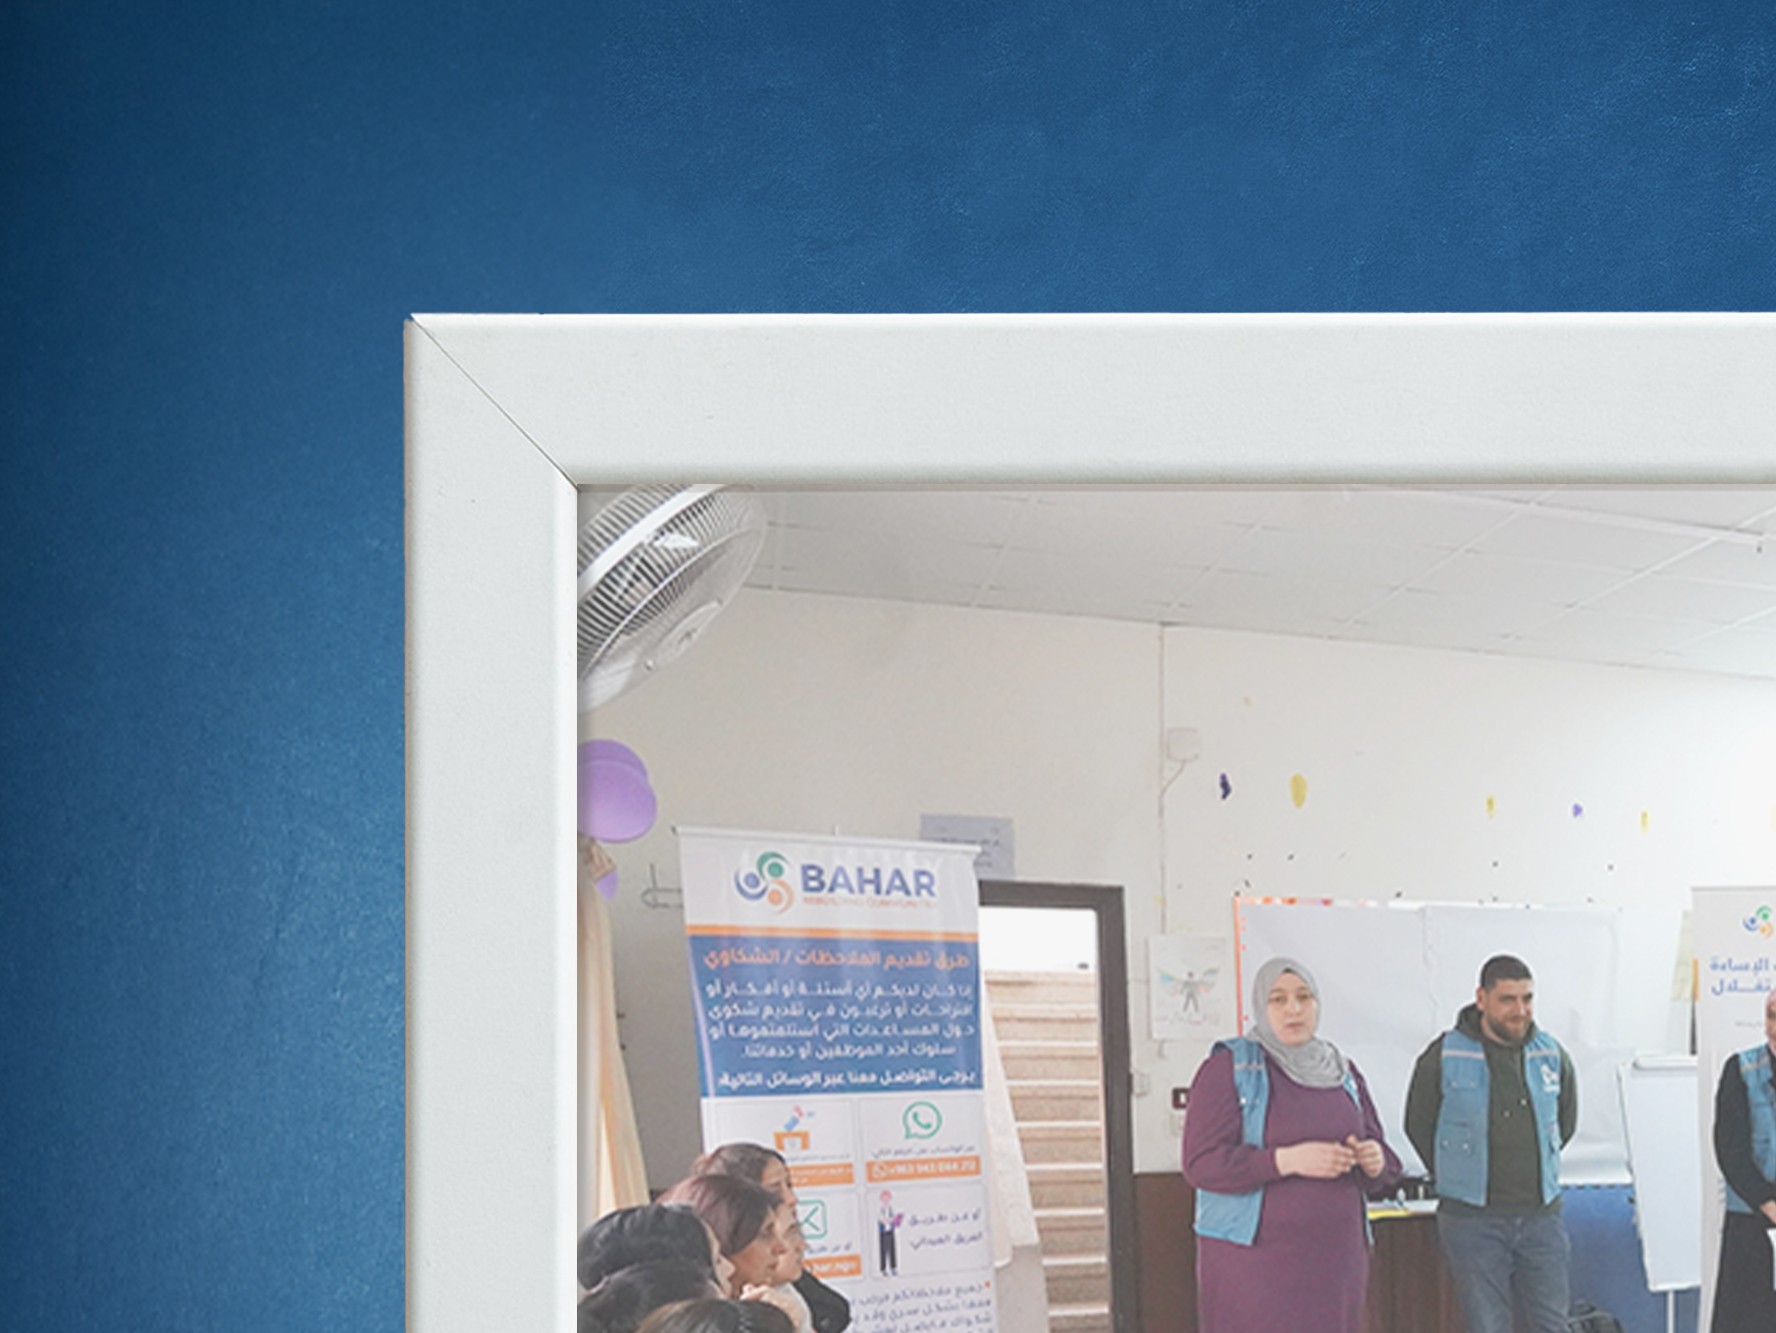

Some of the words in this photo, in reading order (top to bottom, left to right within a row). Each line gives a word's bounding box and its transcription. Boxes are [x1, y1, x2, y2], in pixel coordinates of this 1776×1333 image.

[801, 863, 936, 898] BAHAR
[882, 949, 931, 972] تقديم
[935, 949, 970, 971] طرق
[704, 977, 720, 999] أو
[708, 1020, 725, 1041] أو
